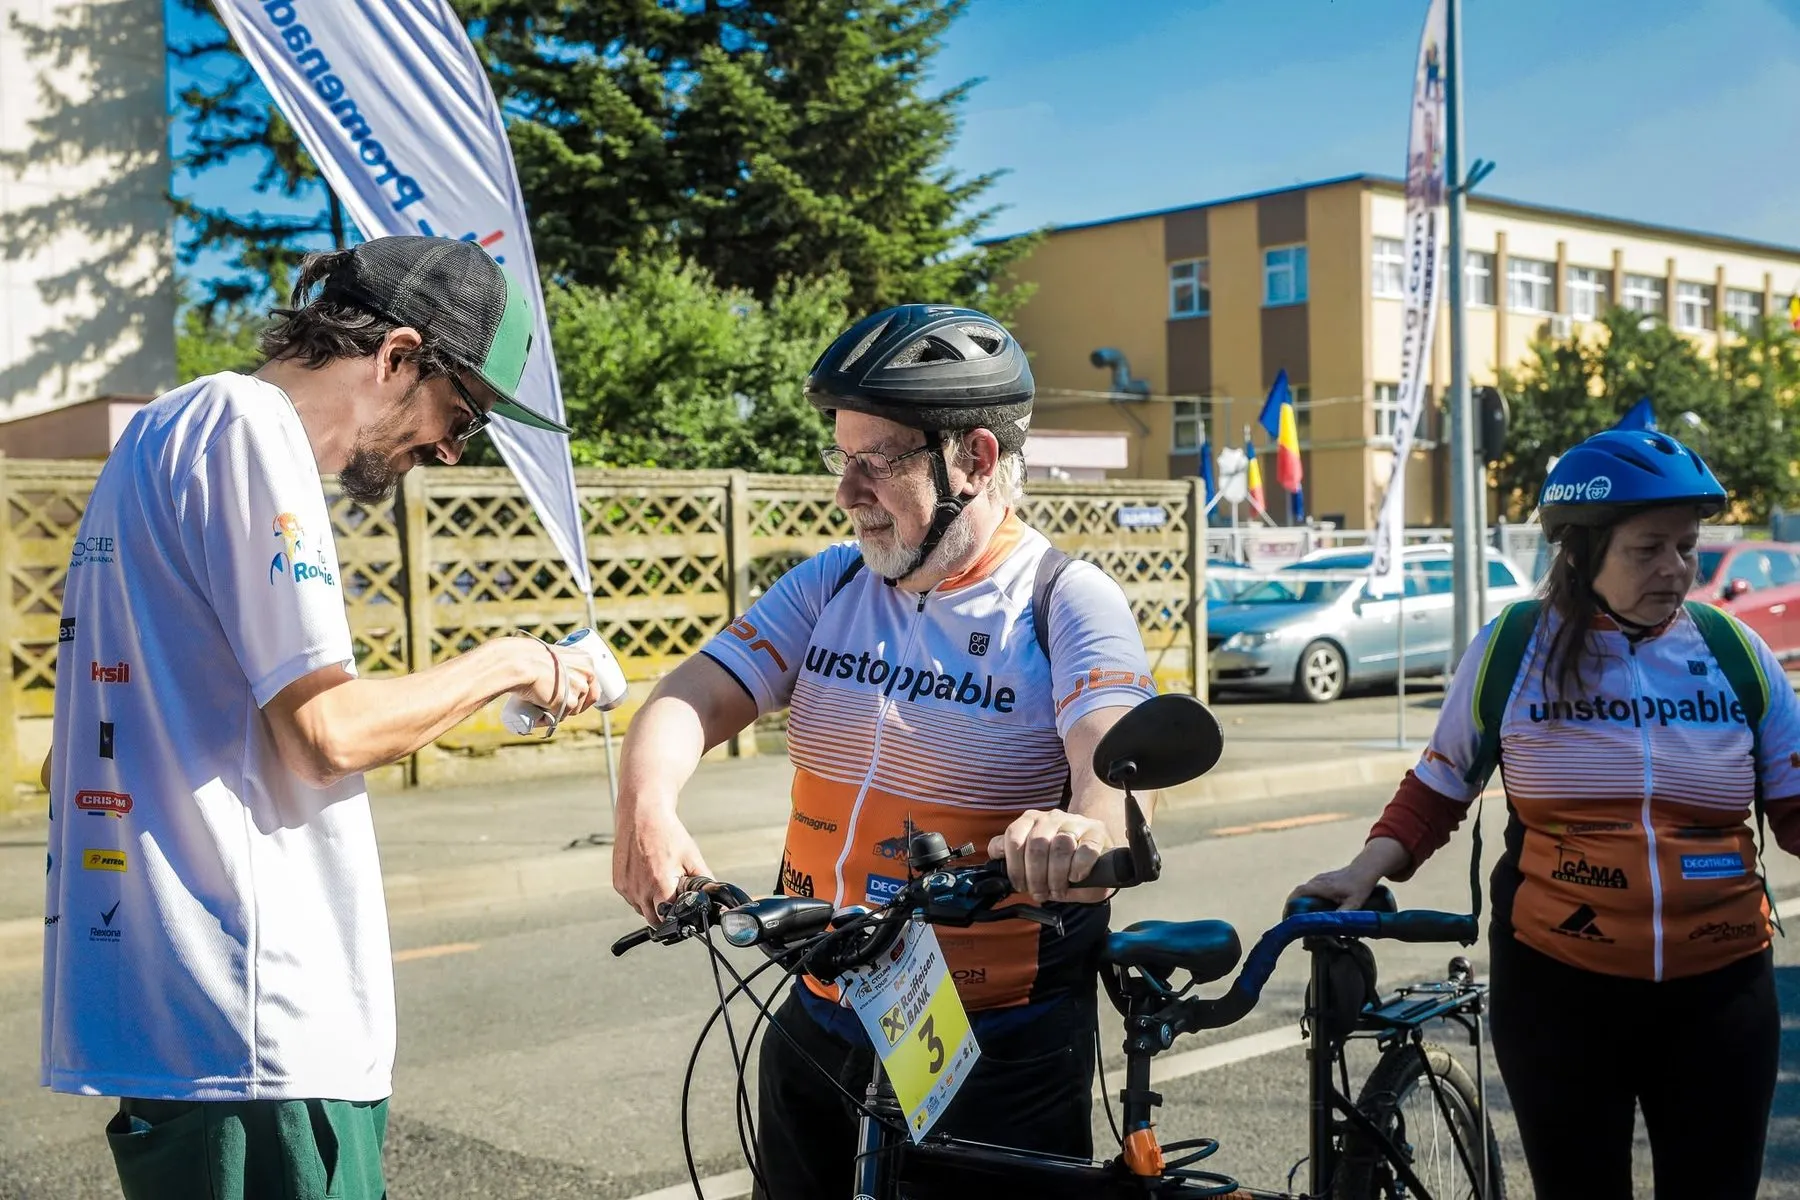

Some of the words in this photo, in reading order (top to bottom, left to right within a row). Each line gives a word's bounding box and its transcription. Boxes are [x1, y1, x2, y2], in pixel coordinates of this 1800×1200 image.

[1543, 481, 1587, 503] KIDDY
[91, 661, 130, 683] Prsil
[1530, 690, 1746, 728] unstoppable
[785, 861, 814, 889] AMA
[1563, 859, 1626, 882] GAMA
[90, 927, 121, 937] Rexona
[901, 951, 936, 1010] Raiffeisen
[907, 985, 931, 1026] BANK
[918, 1014, 945, 1075] 3
